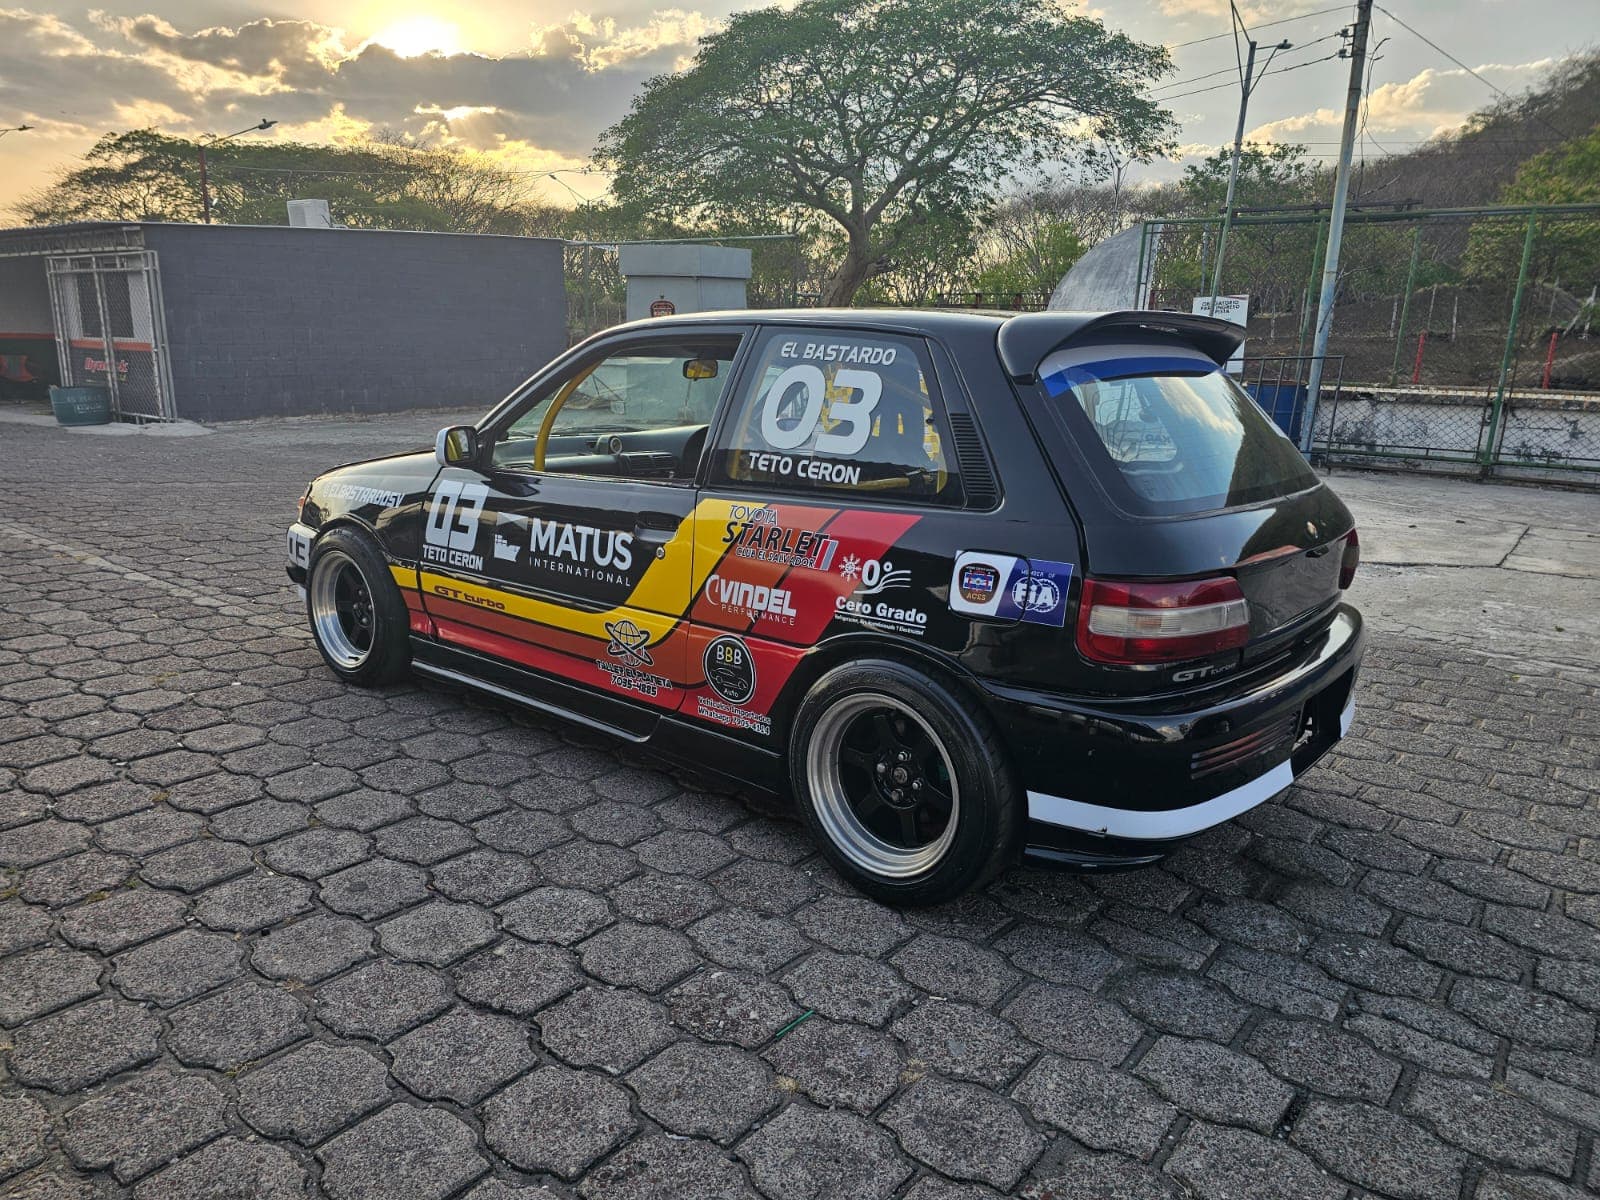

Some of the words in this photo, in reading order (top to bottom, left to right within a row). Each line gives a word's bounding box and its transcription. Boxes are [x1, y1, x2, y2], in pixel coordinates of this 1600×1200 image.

[781, 342, 798, 359] EL
[802, 343, 896, 366] BASTARDO
[761, 364, 882, 455] 03
[749, 452, 792, 475] TETO
[797, 459, 860, 485] CERON
[425, 479, 490, 552] 03
[729, 504, 778, 526] TOYOTA
[287, 524, 311, 570] 03
[530, 517, 633, 571] MATUS
[721, 520, 831, 558] STARLET
[422, 544, 447, 563] TETO
[448, 549, 484, 571] CERON
[529, 556, 631, 587] INTERNATIONAL
[735, 546, 756, 558] CLUB
[758, 550, 767, 560] EL
[767, 551, 816, 569] SALVADOR
[434, 585, 462, 598] GT
[463, 592, 506, 610] turbo
[720, 578, 797, 617] VINDEL
[835, 595, 872, 614] Cero
[875, 602, 928, 624] Grado
[721, 603, 795, 626] PERFORMANCE
[716, 644, 742, 665] BBB
[1172, 664, 1215, 682] GT
